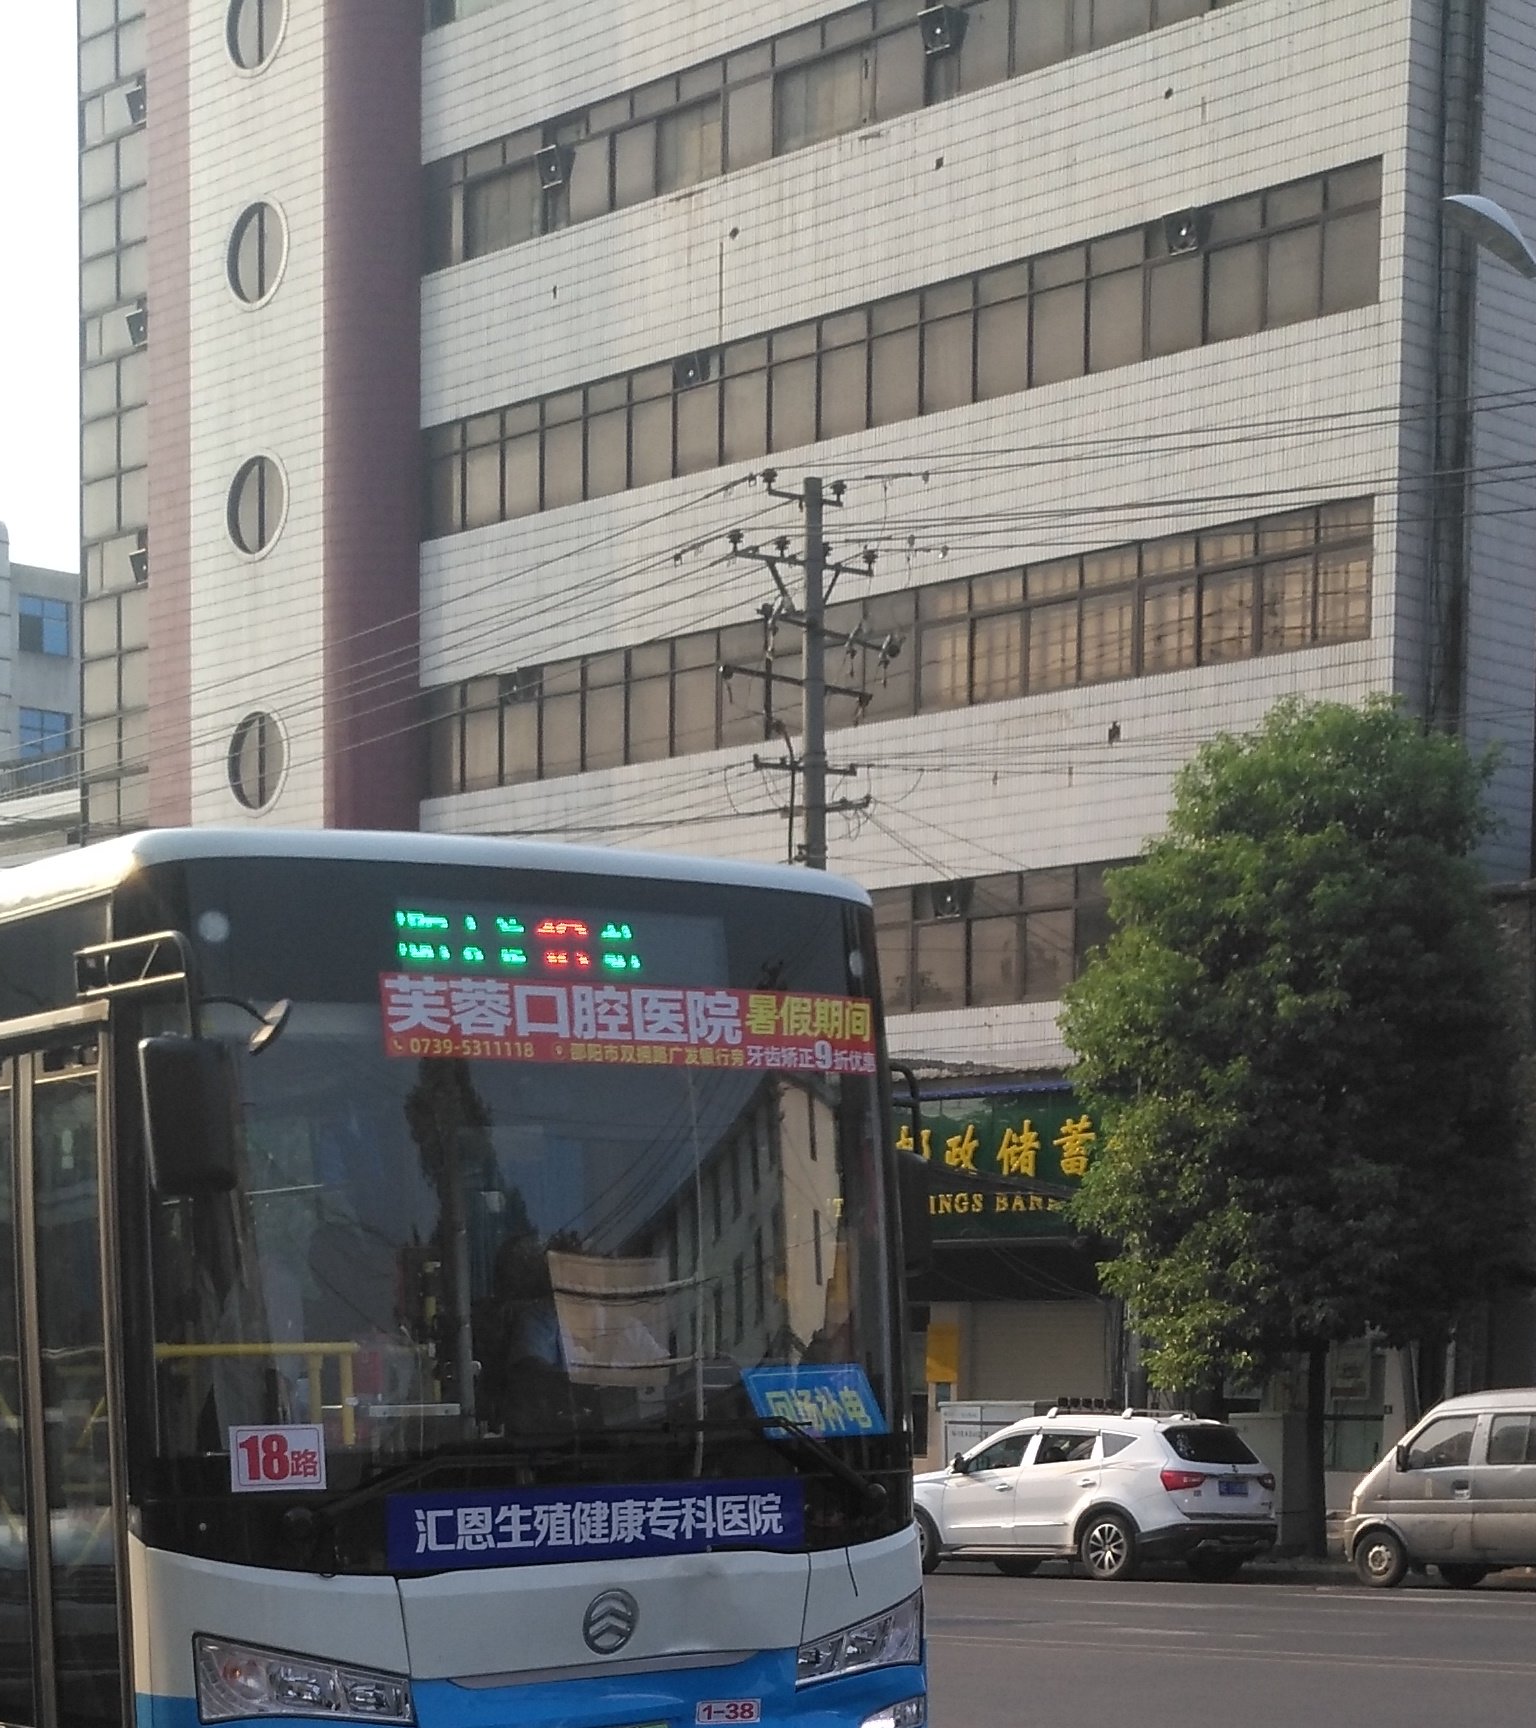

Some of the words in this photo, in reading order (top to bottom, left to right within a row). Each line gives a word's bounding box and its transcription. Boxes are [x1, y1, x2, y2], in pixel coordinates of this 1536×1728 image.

[384, 974, 742, 1045] 芙蓉口腔医院
[745, 993, 871, 1042] 暑假期间
[410, 1037, 535, 1059] 0739-5311118
[929, 1192, 984, 1215] INGS
[239, 1434, 318, 1481] 18路
[414, 1492, 784, 1554] 汇恩生殖健康专科医院
[702, 1702, 755, 1721] 1-38
